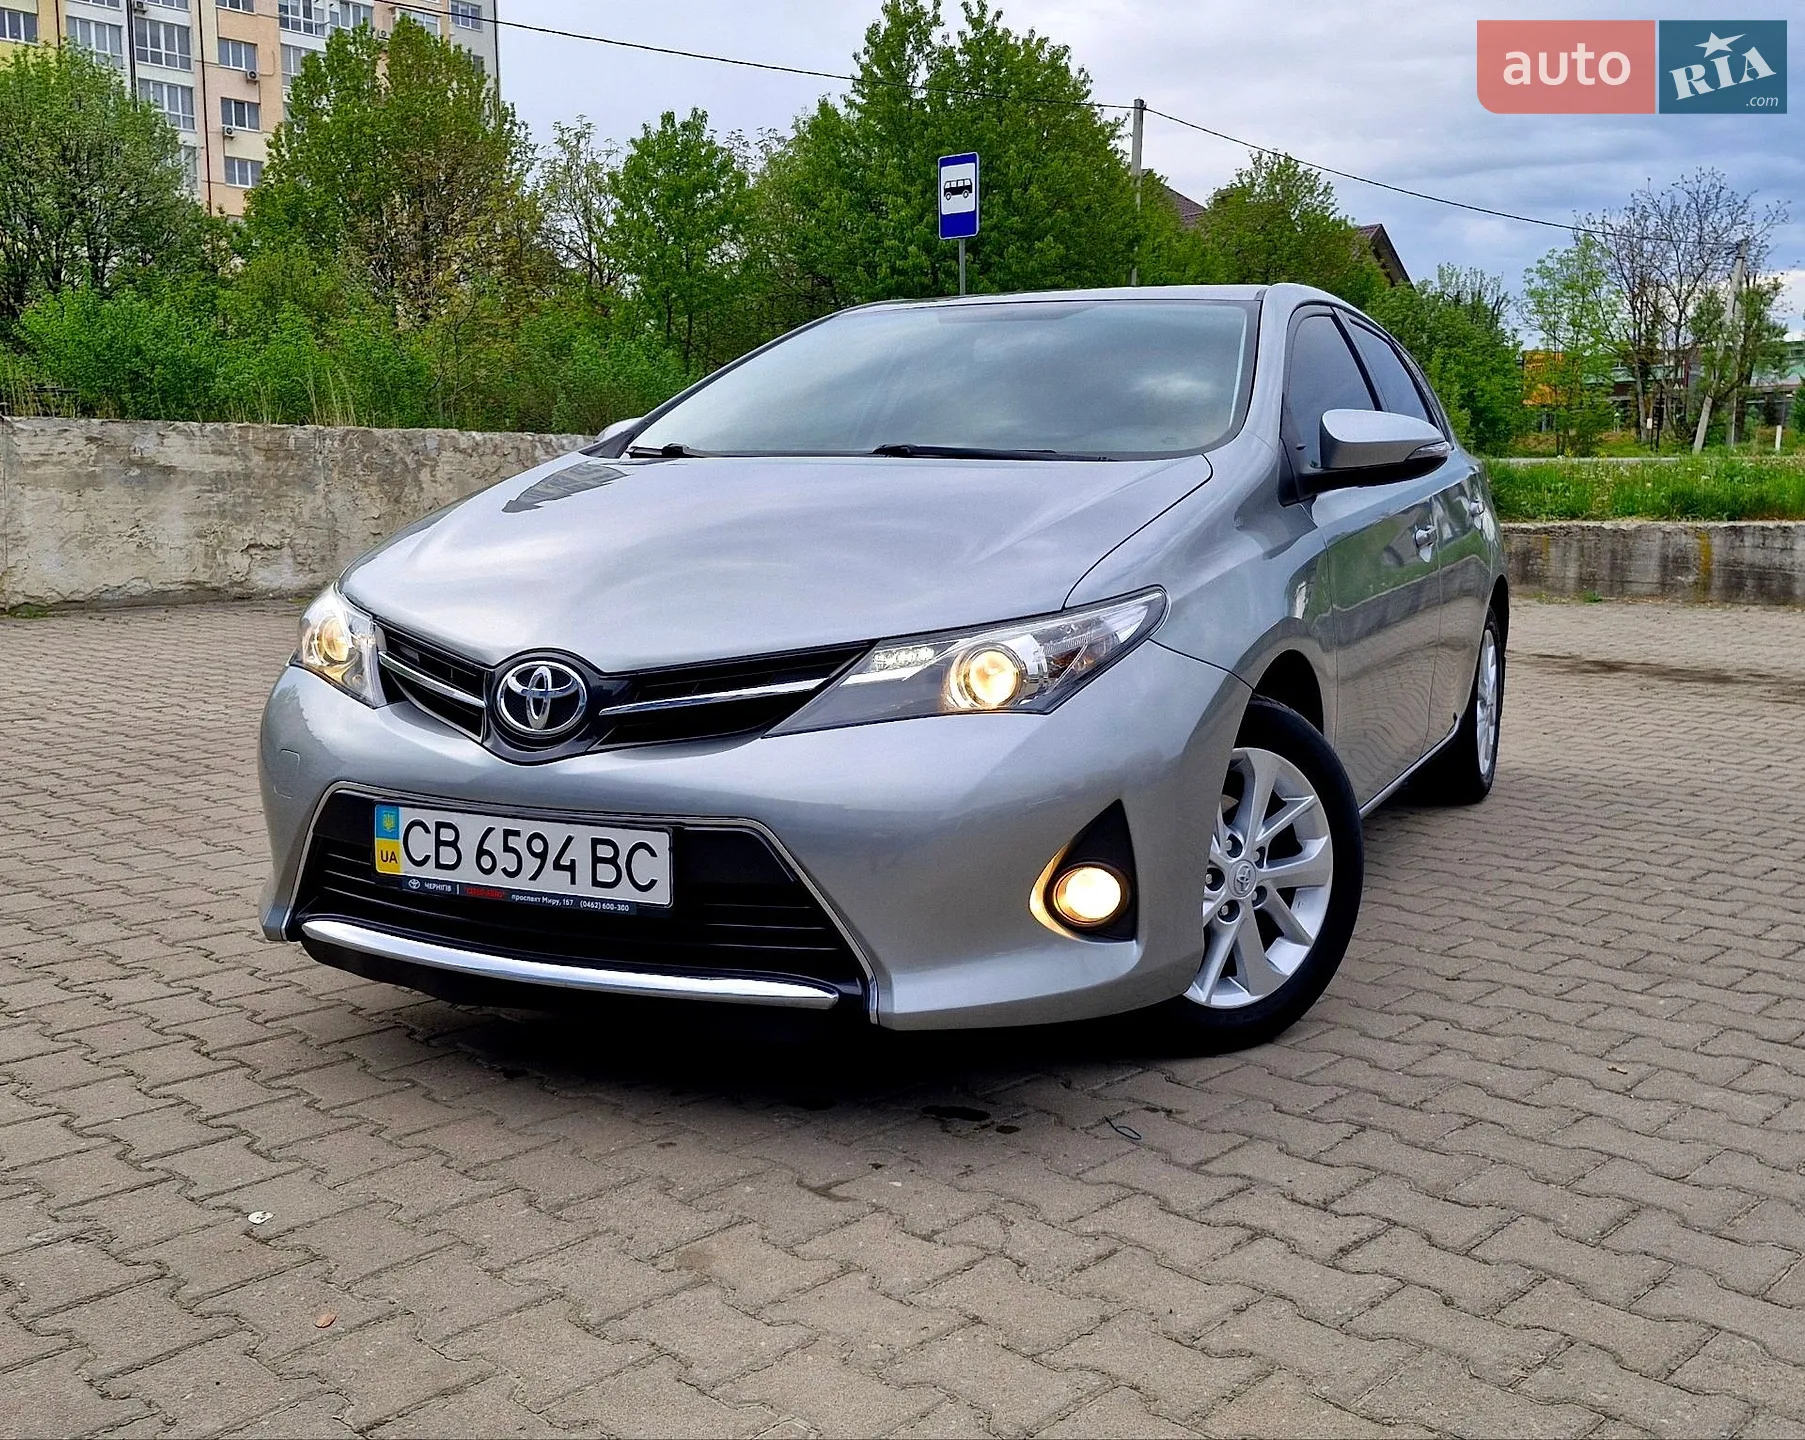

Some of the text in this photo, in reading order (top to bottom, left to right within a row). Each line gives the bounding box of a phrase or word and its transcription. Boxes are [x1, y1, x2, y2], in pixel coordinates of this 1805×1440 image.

[380, 849, 398, 865] UA
[403, 818, 659, 893] CB 6594 BC
